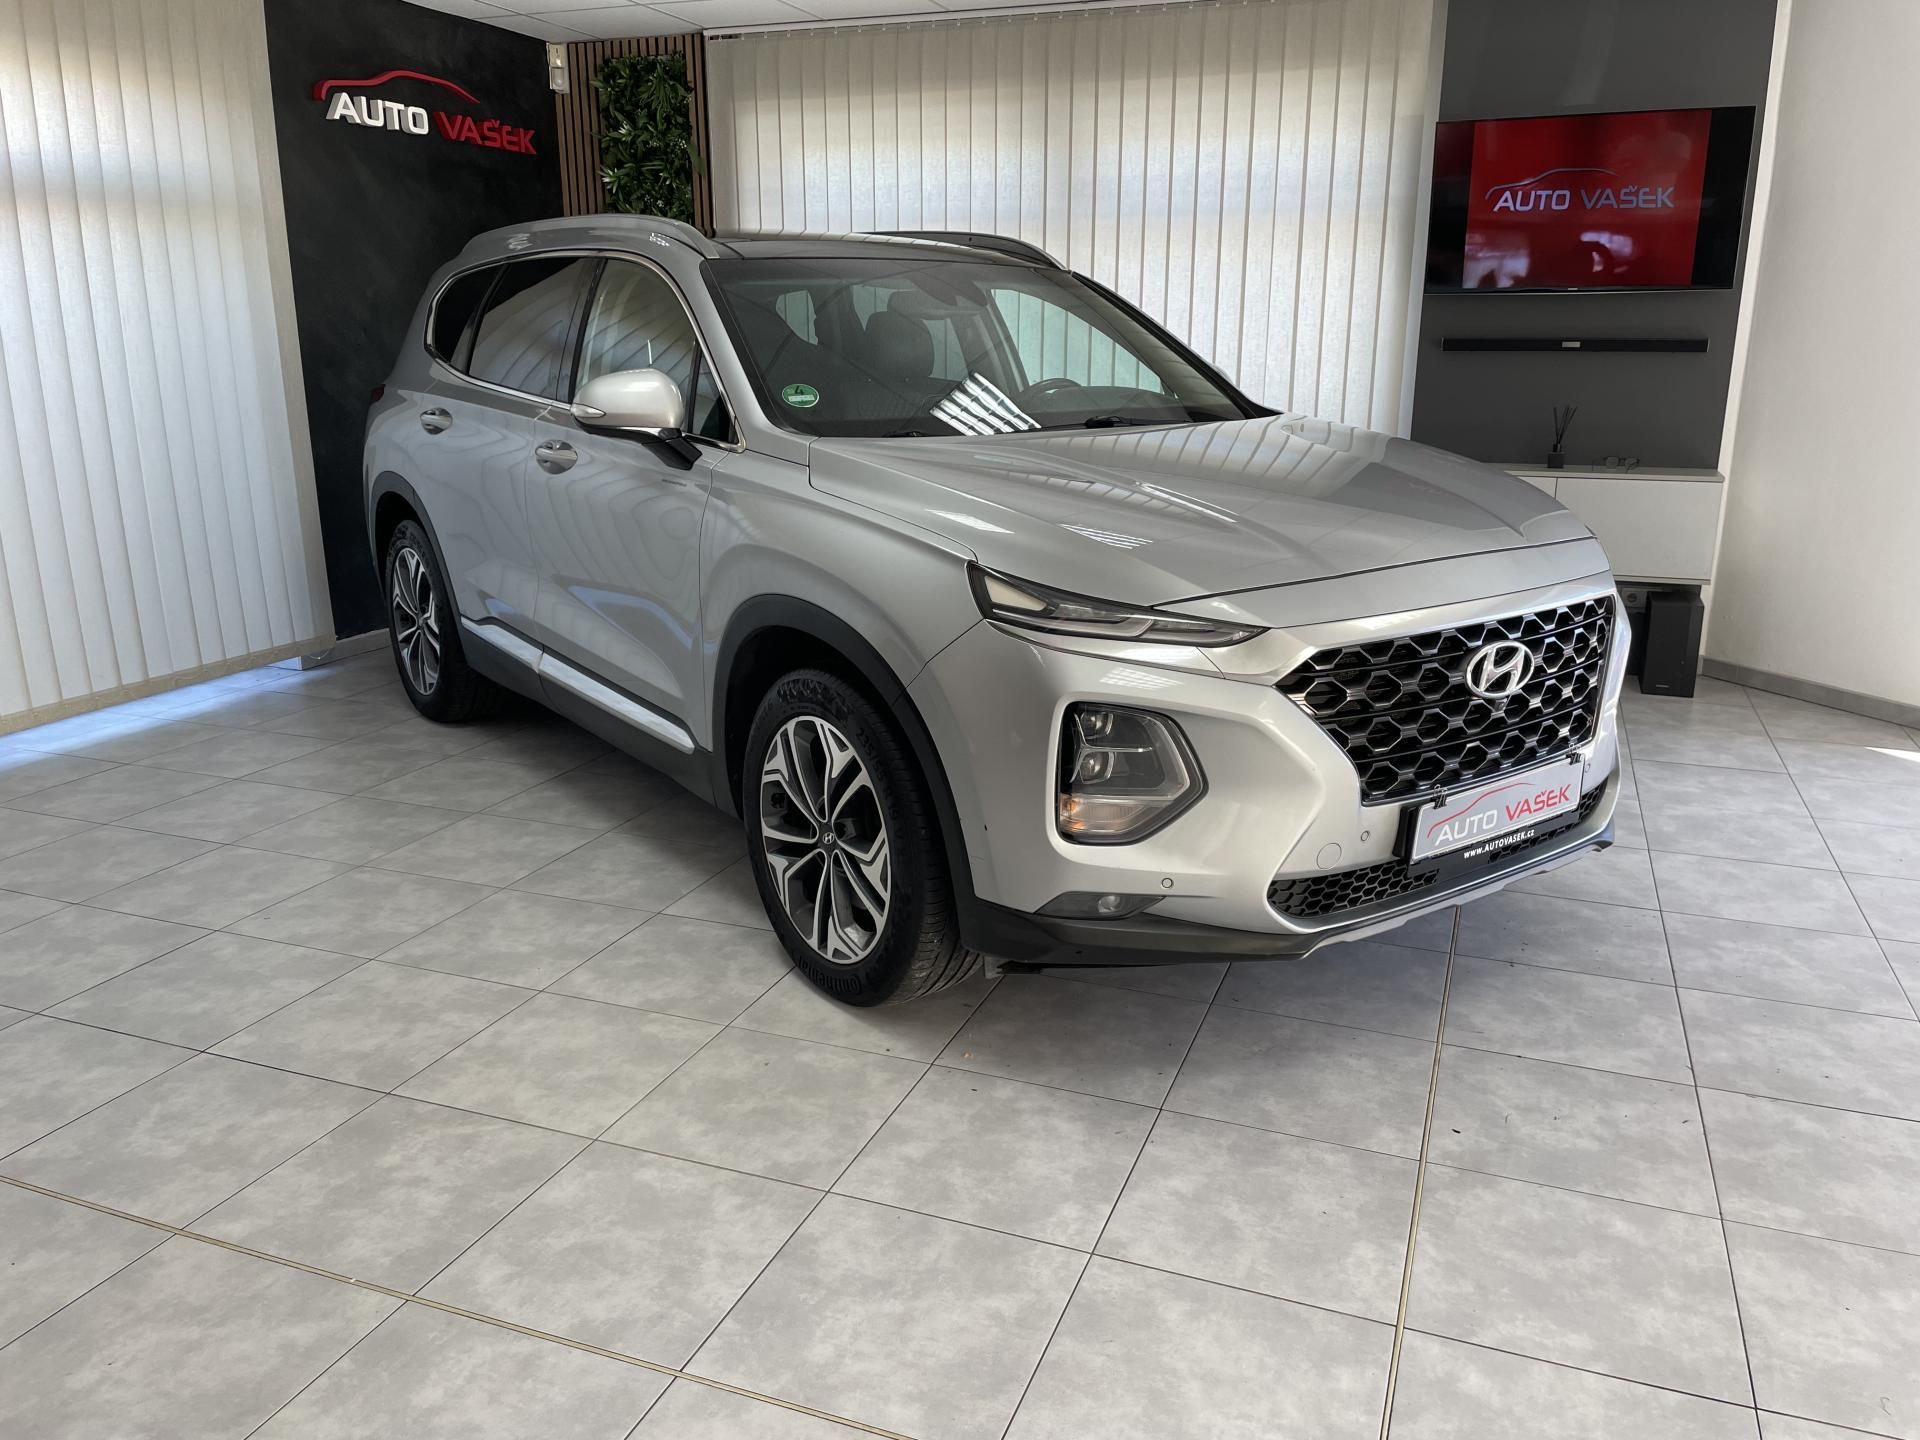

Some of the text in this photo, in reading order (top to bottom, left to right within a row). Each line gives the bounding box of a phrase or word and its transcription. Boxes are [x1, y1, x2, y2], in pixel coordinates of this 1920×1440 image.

[326, 92, 537, 155] AUTO VAŠEK
[1493, 185, 1675, 212] AUTO VAŠEK
[1435, 784, 1571, 846] AUTO VAŠEK
[1463, 829, 1535, 859] www.AUTOVASEK.cz
